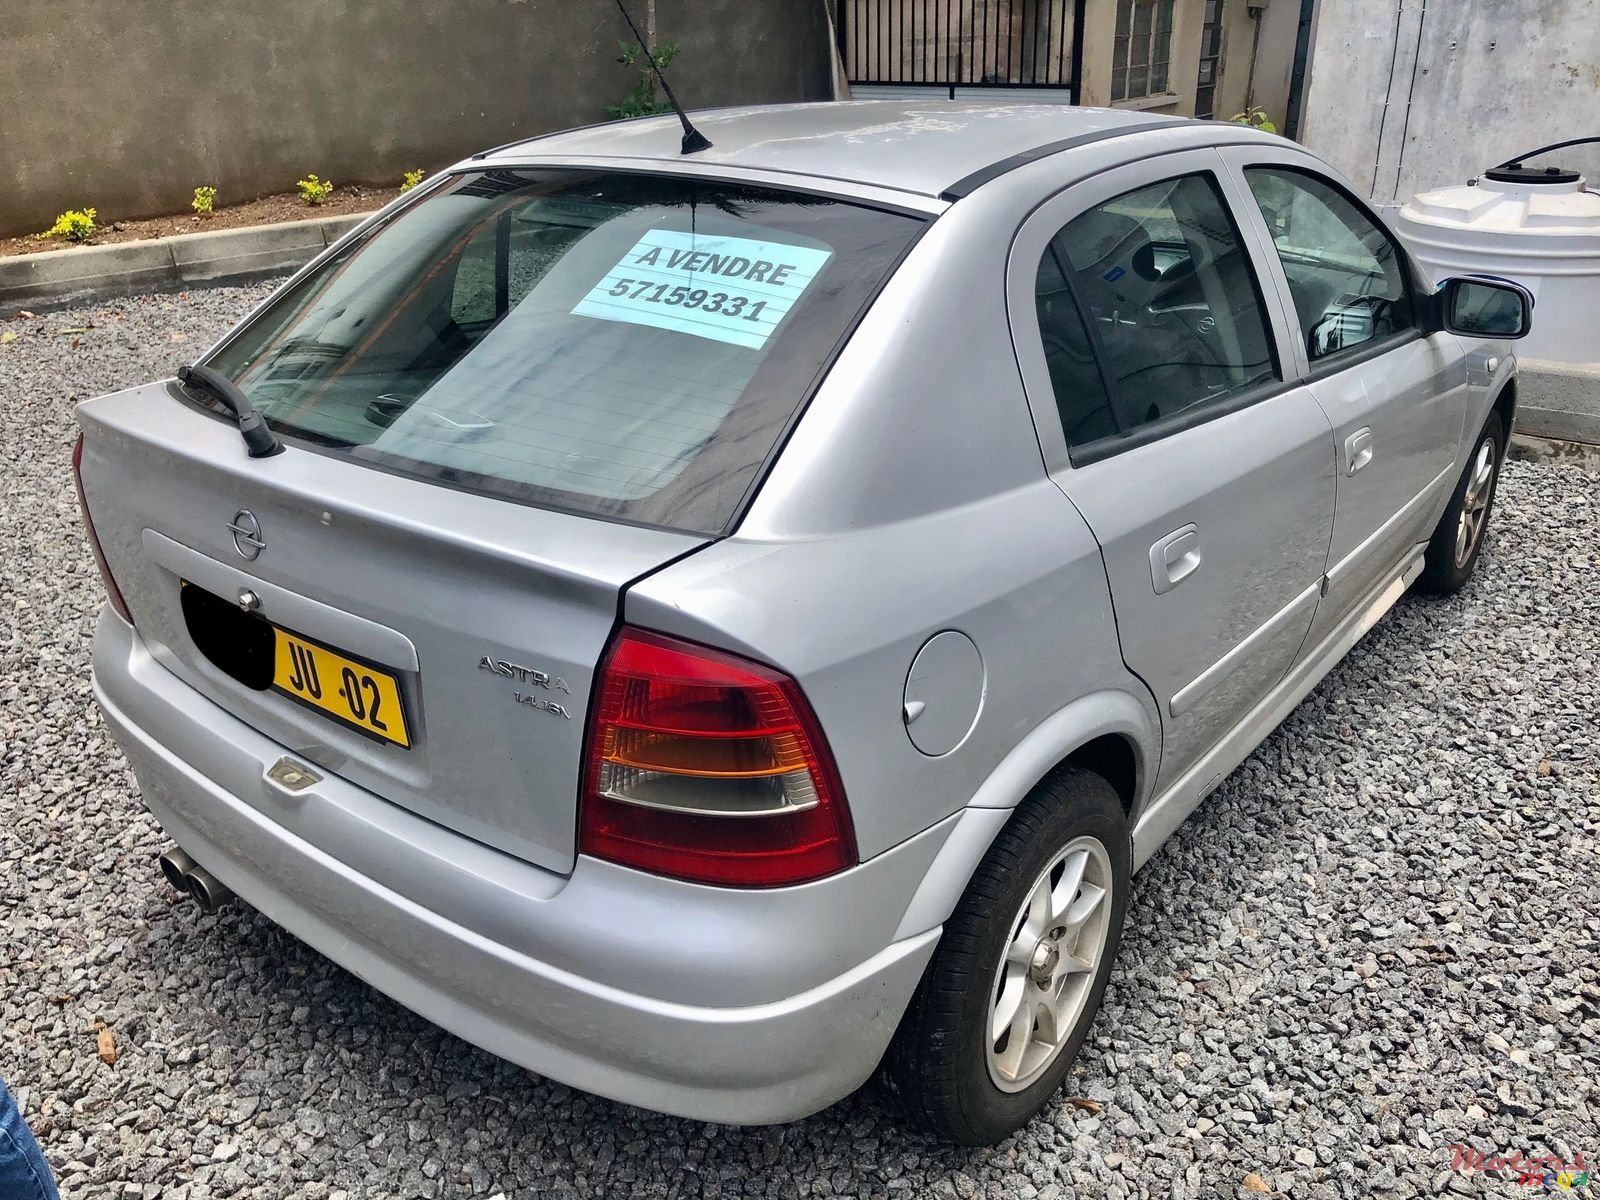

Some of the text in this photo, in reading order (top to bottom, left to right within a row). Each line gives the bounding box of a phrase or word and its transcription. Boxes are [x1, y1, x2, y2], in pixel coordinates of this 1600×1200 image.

[634, 247, 797, 286] A VENDRE
[608, 278, 768, 322] 57159331
[288, 641, 322, 700] JU
[478, 656, 571, 695] ASTRA
